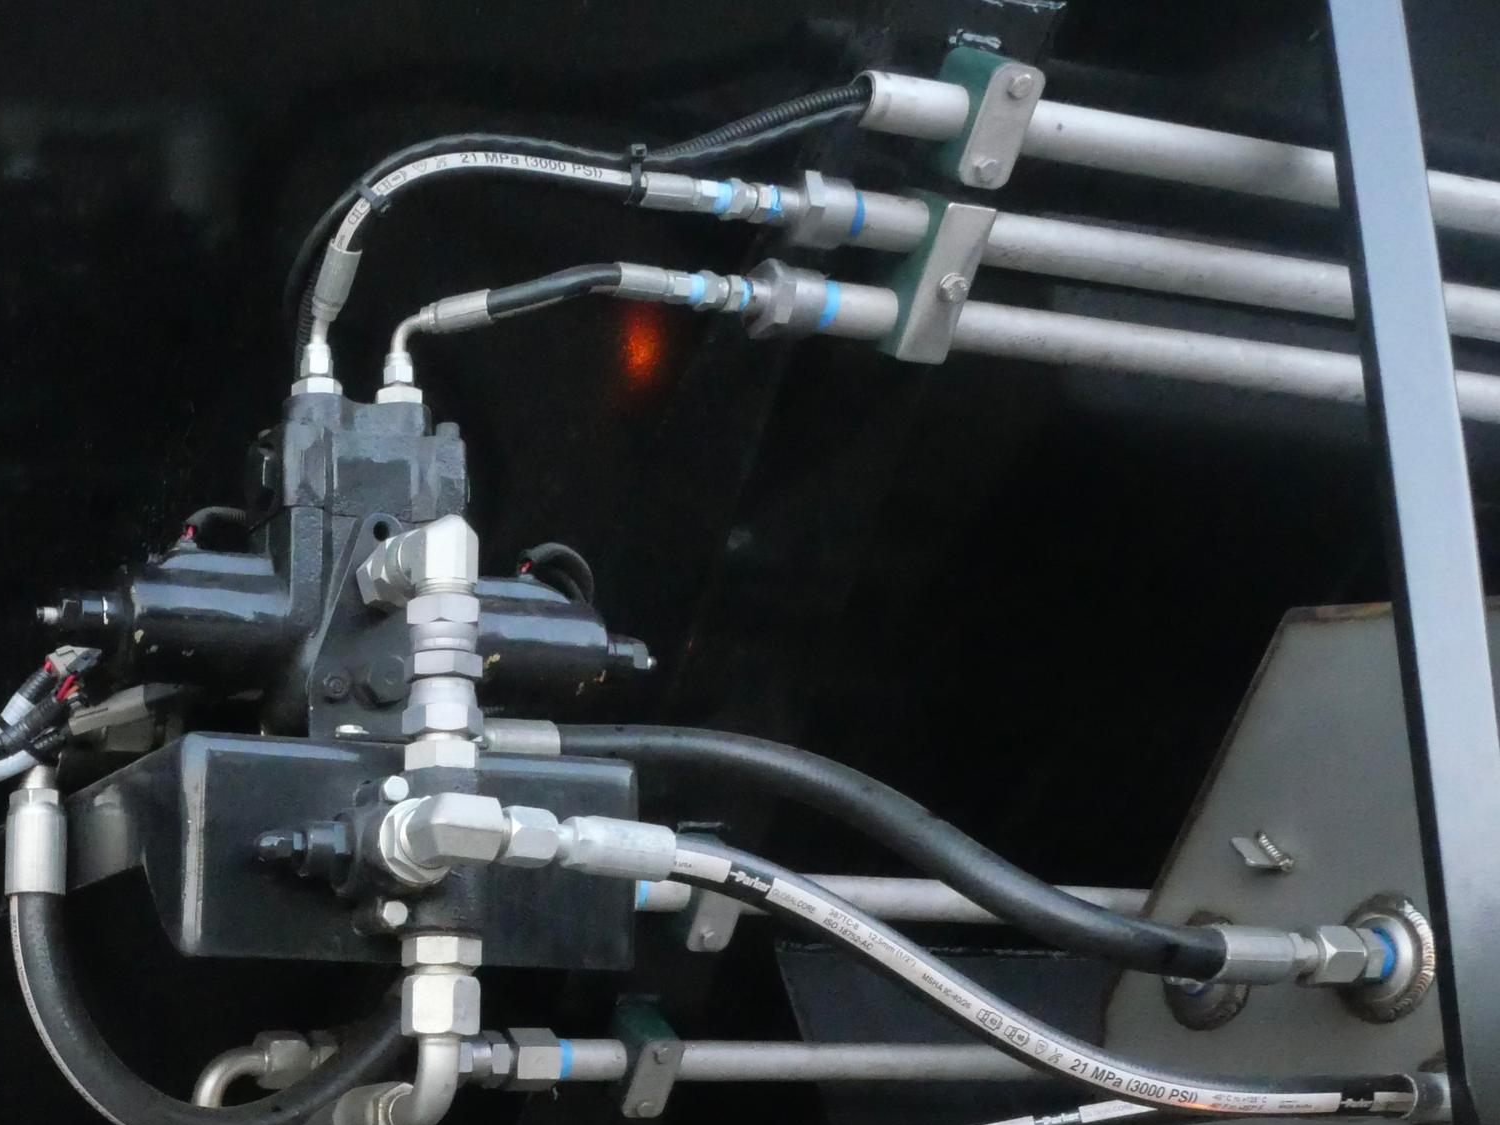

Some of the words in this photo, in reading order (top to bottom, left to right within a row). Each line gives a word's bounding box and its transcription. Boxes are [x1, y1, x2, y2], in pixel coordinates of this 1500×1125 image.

[460, 153, 478, 164] 21
[485, 153, 519, 165] MPa
[524, 156, 566, 173] (3000
[571, 162, 603, 179] PSI)
[735, 871, 771, 892] Parker
[1070, 1058, 1089, 1074] 21
[1090, 1066, 1123, 1088] MPa
[1126, 1078, 1165, 1099] (3000
[1168, 1089, 1198, 1104] PSI)
